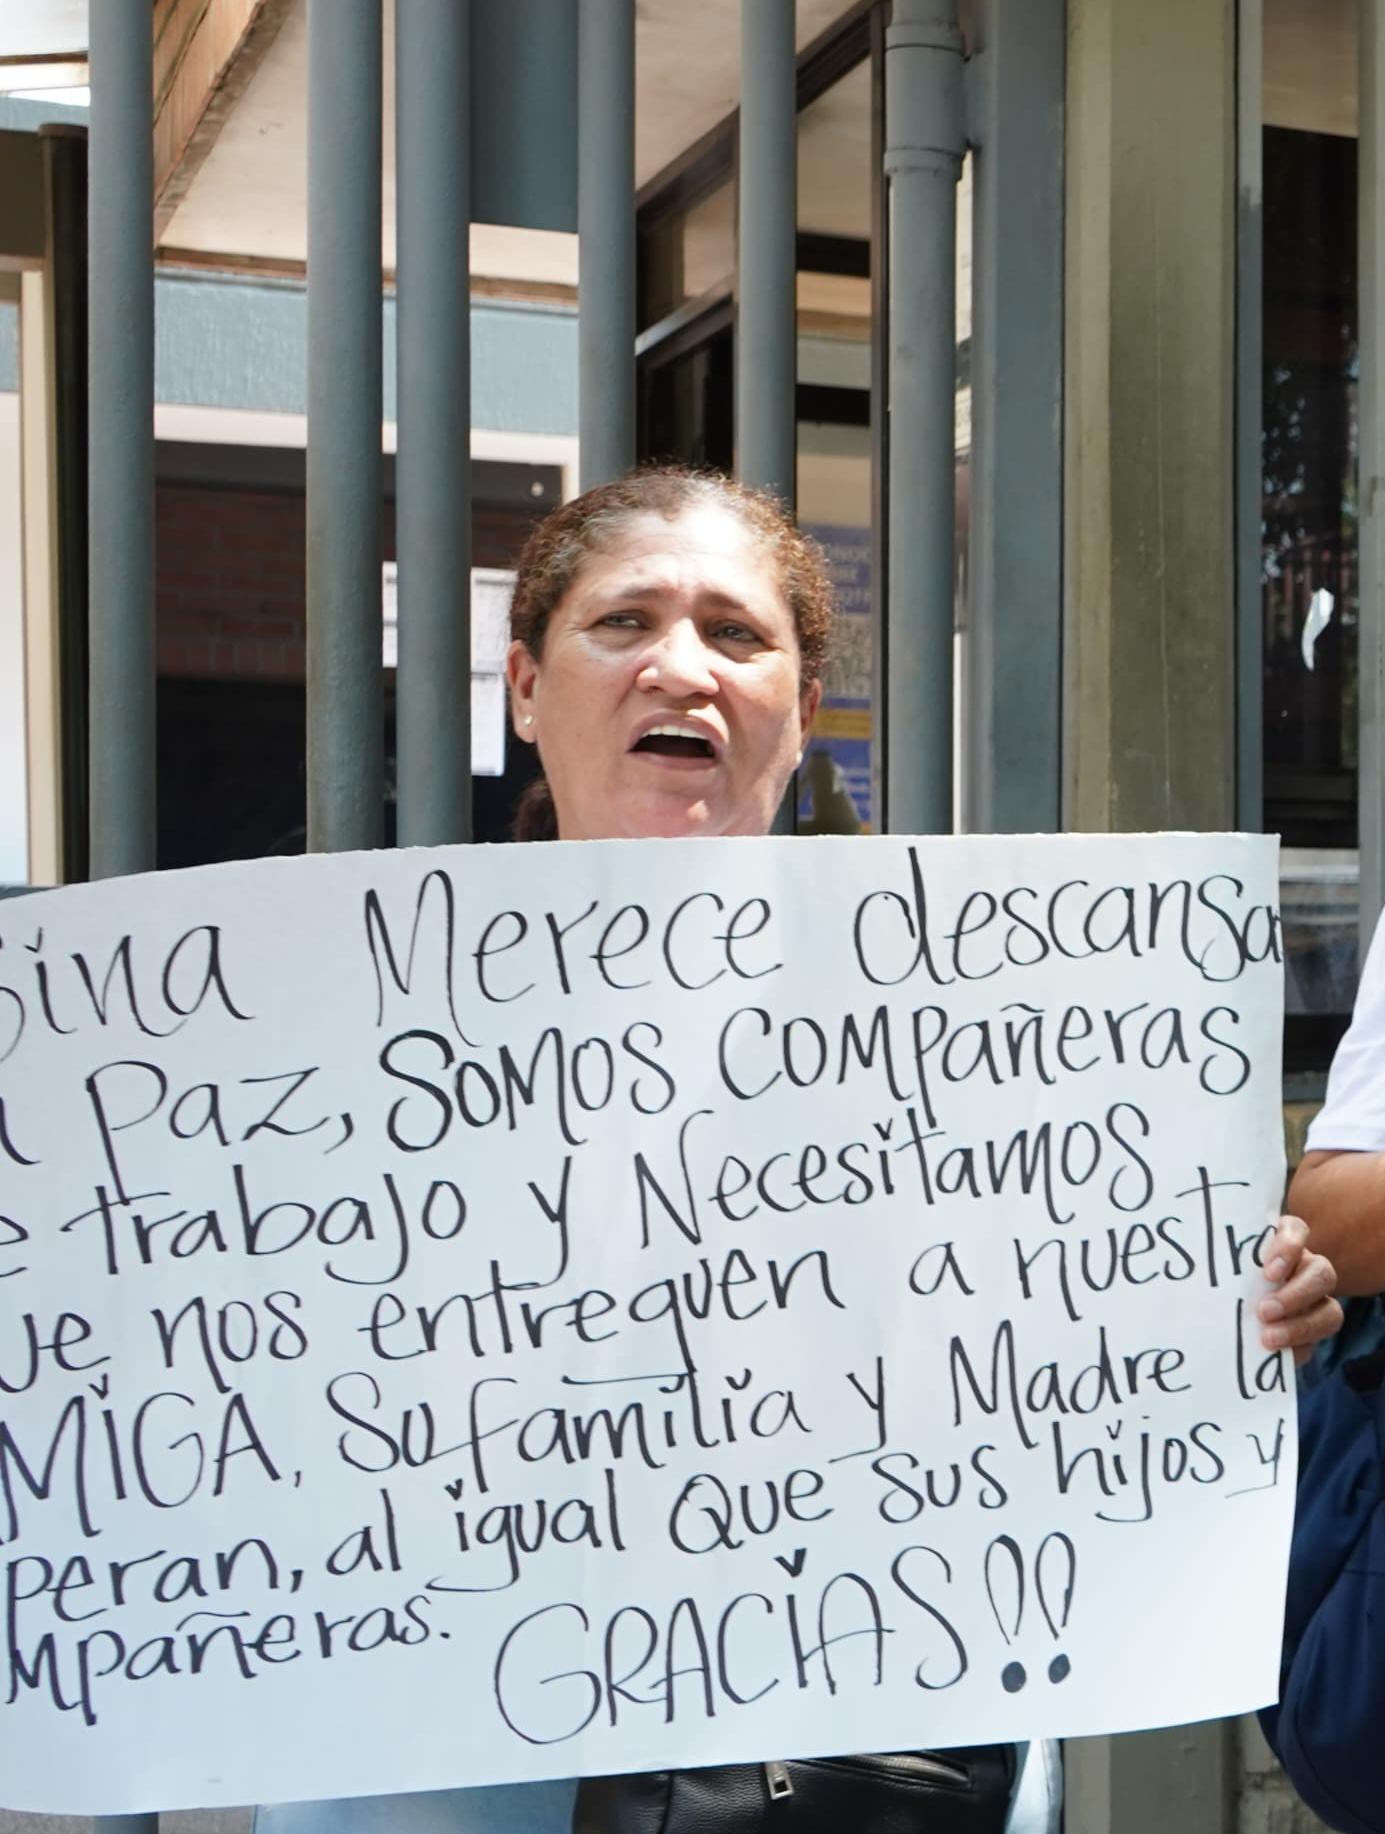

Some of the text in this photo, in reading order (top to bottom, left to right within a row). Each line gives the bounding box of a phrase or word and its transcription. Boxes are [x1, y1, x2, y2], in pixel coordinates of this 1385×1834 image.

[364, 869, 783, 1048] Merece
[60, 1164, 467, 1285] trabajo
[527, 1156, 572, 1287] y
[634, 1102, 1154, 1246] Necesitamos
[151, 1291, 308, 1393] nos
[358, 1259, 846, 1384] entreguen
[909, 1242, 974, 1296] a
[829, 1356, 885, 1463] y
[950, 1319, 1192, 1449] Madre
[1235, 1298, 1287, 1400] la
[326, 1488, 402, 1573] al
[425, 1468, 626, 1592] igual
[1052, 1415, 1226, 1522] hijos
[1223, 1417, 1285, 1499] y
